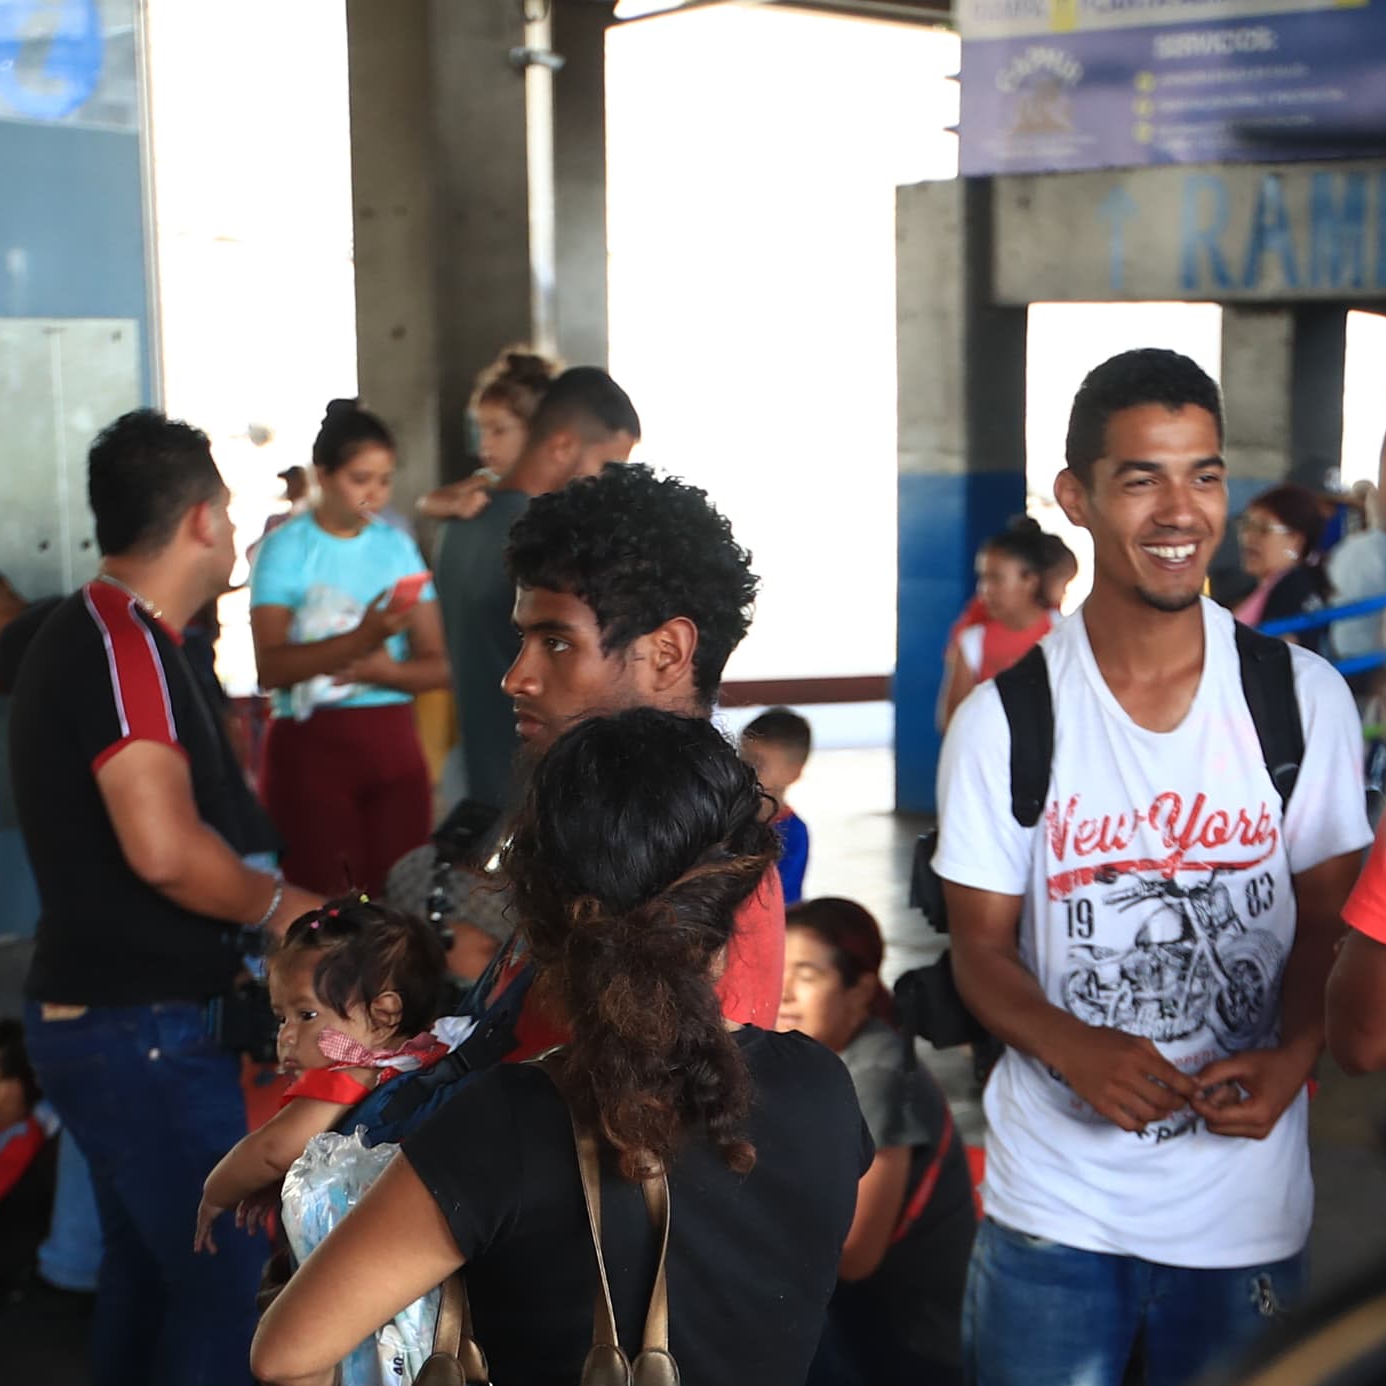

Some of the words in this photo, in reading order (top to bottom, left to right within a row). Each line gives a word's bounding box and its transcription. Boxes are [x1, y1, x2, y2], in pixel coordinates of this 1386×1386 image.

[1045, 795, 1144, 863] New
[1148, 791, 1279, 878] York
[1063, 898, 1095, 939] 19
